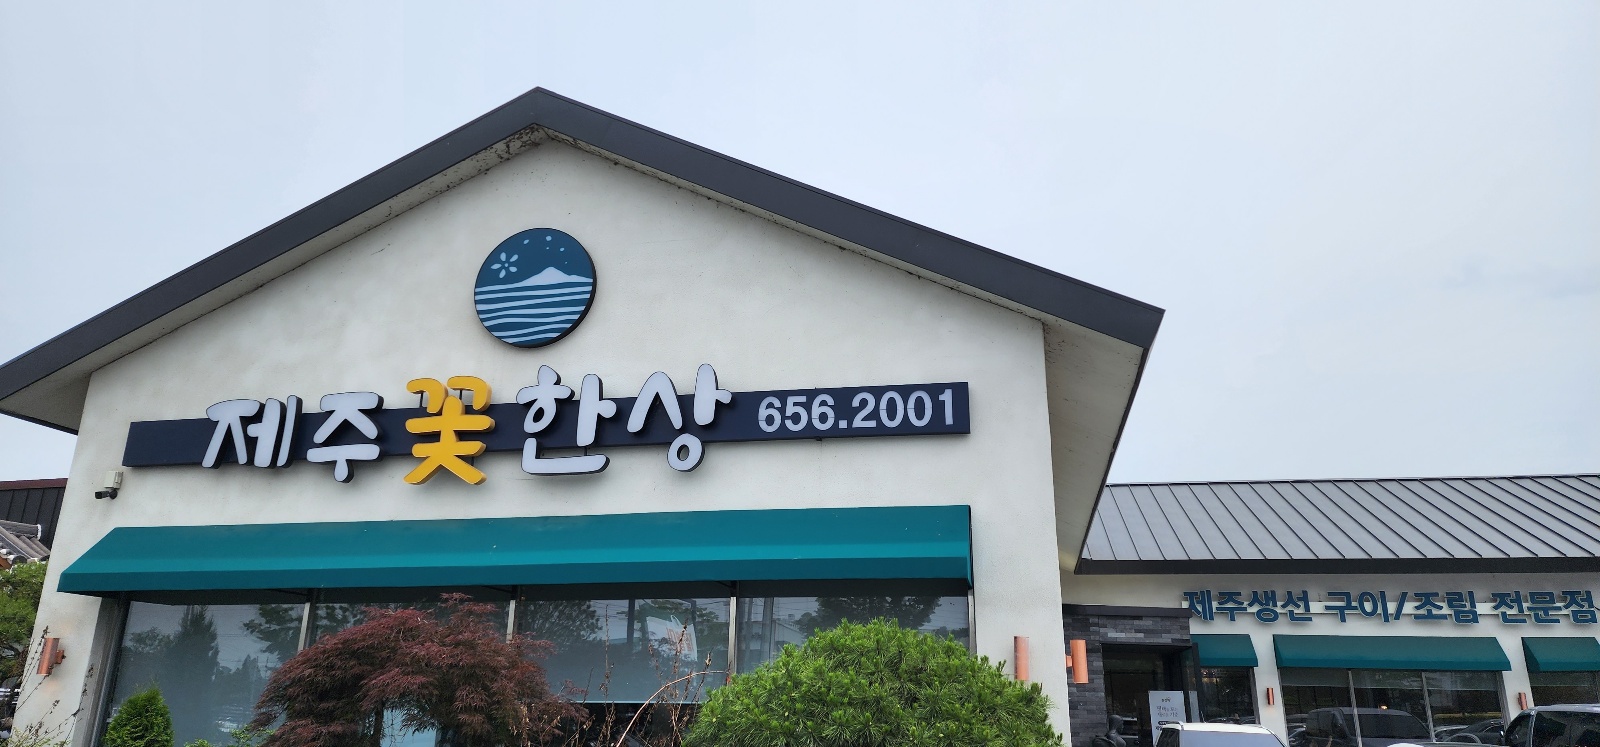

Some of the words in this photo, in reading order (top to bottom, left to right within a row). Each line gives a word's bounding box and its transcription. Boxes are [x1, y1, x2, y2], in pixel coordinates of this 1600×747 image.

[758, 389, 954, 433] 656.2001
[1183, 589, 1313, 623] 제주생선
[1324, 590, 1480, 624] 구이/조림
[1491, 590, 1598, 624] 전문점
